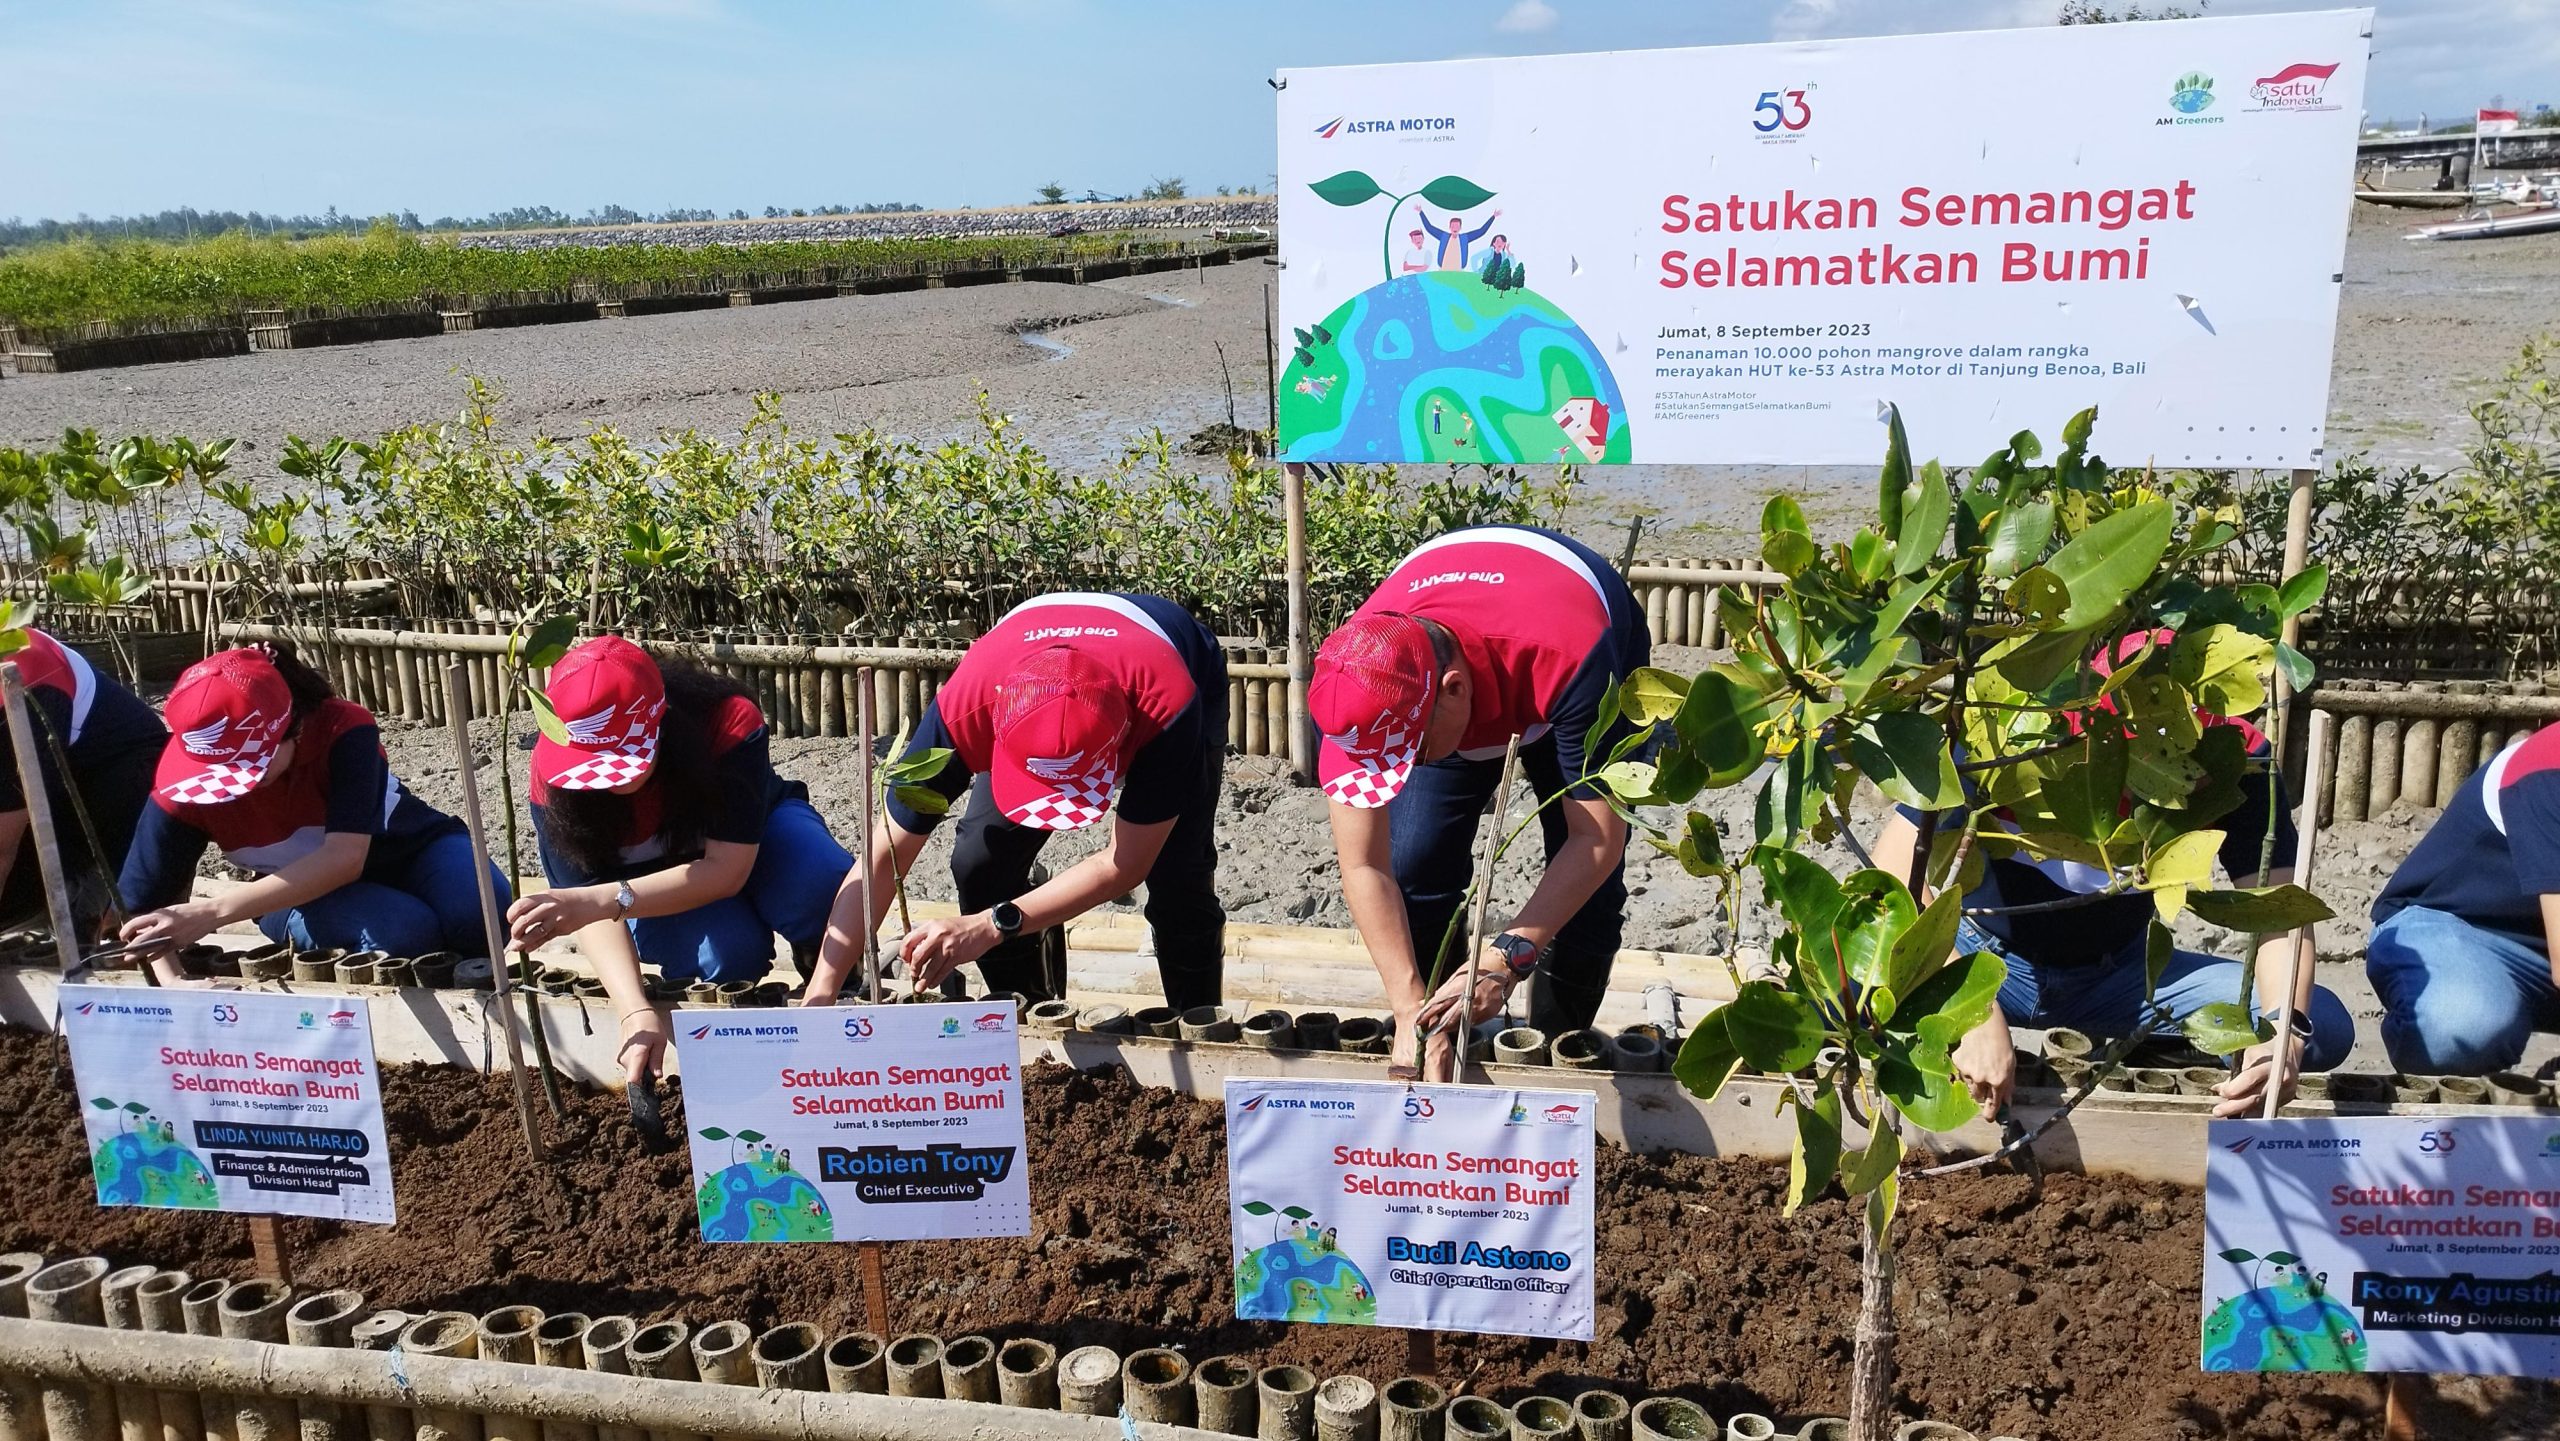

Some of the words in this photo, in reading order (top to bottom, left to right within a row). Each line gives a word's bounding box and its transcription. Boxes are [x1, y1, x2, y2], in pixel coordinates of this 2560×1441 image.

[2262, 96, 2323, 108] Indonesia
[1347, 120, 1395, 134] ASTRA
[1400, 117, 1456, 131] MOTOR
[2155, 117, 2173, 126] AM
[2176, 115, 2224, 126] Greeners
[1433, 135, 1455, 143] ASTRA
[1661, 190, 1878, 234] Satukan
[1899, 180, 2196, 231] Semangat
[1659, 245, 1978, 289] Selamatkan
[2001, 237, 2150, 283] Bumi
[1657, 325, 1711, 340] Jumat,
[1716, 325, 1726, 338] 8
[1732, 324, 1823, 340] September
[1828, 323, 1871, 337] 2023
[1656, 346, 1748, 360] Penanaman
[1754, 346, 1812, 359] 10.000
[1818, 345, 1871, 361] pohon
[1877, 346, 1963, 360] mangrove
[1969, 344, 2022, 358] dalam
[2028, 343, 2089, 358] rangka
[1655, 364, 1743, 380] merayakan
[1749, 364, 1783, 377] HUT
[1789, 363, 1834, 377] ke-53
[1841, 363, 1885, 377] Astra
[1891, 363, 1941, 377] Motor
[1947, 362, 1963, 376] di
[1969, 363, 2039, 378] Tanjung
[2045, 362, 2106, 378] Benoa,
[2112, 361, 2146, 375] Bali
[1655, 391, 1757, 400] #53TahunAstraMotor
[1655, 402, 1832, 412] #SatukanSemangatSelamatkanBumi
[1654, 412, 1720, 421] #AMGreeners
[1468, 572, 1504, 584] One
[1084, 627, 1119, 637] One
[568, 735, 620, 745] HONDA
[184, 745, 237, 756] HONDA
[98, 1005, 132, 1015] ASTRA
[134, 1006, 173, 1016] MOTOR
[714, 1027, 752, 1037] ASTRA
[755, 1026, 798, 1036] MOTOR
[160, 1047, 248, 1069] Satukan
[254, 1051, 365, 1079] Semangat
[781, 1068, 880, 1088] Satukan
[887, 1063, 1012, 1087] Semangat
[172, 1073, 300, 1097] Selamatkan
[306, 1080, 361, 1101] Bumi
[209, 1098, 242, 1110] Jumat,
[244, 1100, 250, 1109] 8
[252, 1101, 304, 1114] September
[306, 1103, 329, 1114] 2023
[793, 1094, 936, 1115] Selamatkan
[944, 1090, 1005, 1112] Bumi
[1266, 1099, 1306, 1109] ASTRA
[1310, 1100, 1355, 1111] MOTOR
[833, 1119, 870, 1131] Jumat,
[872, 1119, 878, 1129] 8
[882, 1117, 940, 1130] September
[943, 1116, 968, 1127] 2023
[201, 1127, 246, 1144] LINDA
[250, 1129, 305, 1147] YUNITA
[308, 1131, 362, 1151] HARJO
[2256, 1139, 2303, 1150] ASTRA
[2307, 1138, 2361, 1149] MOTOR
[219, 1159, 265, 1172] Finance
[268, 1162, 275, 1172] &
[278, 1163, 363, 1178] Administration
[826, 1152, 927, 1176] Robien
[936, 1151, 1005, 1176] Tony
[1333, 1146, 1438, 1171] Satukan
[1445, 1151, 1580, 1182] Semangat
[254, 1174, 300, 1187] Division
[303, 1177, 333, 1189] Head
[863, 1184, 902, 1197] Chief
[905, 1183, 975, 1196] Executive
[1343, 1174, 1496, 1203] Selamatkan
[1505, 1182, 1570, 1206] Bumi
[2331, 1184, 2455, 1208] Satukan
[1384, 1203, 1424, 1215] Jumat,
[1426, 1205, 1434, 1216] 8
[1436, 1206, 1500, 1220] September
[1502, 1209, 1530, 1222] 2023
[2339, 1215, 2522, 1238] Selamatkan
[2533, 1216, 2560, 1238] B
[1387, 1236, 1456, 1265] Budi
[1461, 1241, 1571, 1271] Astono
[2386, 1243, 2432, 1255] Jumat,
[2436, 1243, 2445, 1254] 8
[2449, 1243, 2524, 1256] September
[2527, 1244, 2560, 1256] 2023
[1390, 1269, 1434, 1286] Chief
[1434, 1271, 1513, 1291] Operation
[1515, 1277, 1569, 1294] Officer
[2362, 1279, 2441, 1305] Rony
[2373, 1310, 2462, 1327] Marketing
[2468, 1312, 2543, 1327] Division
